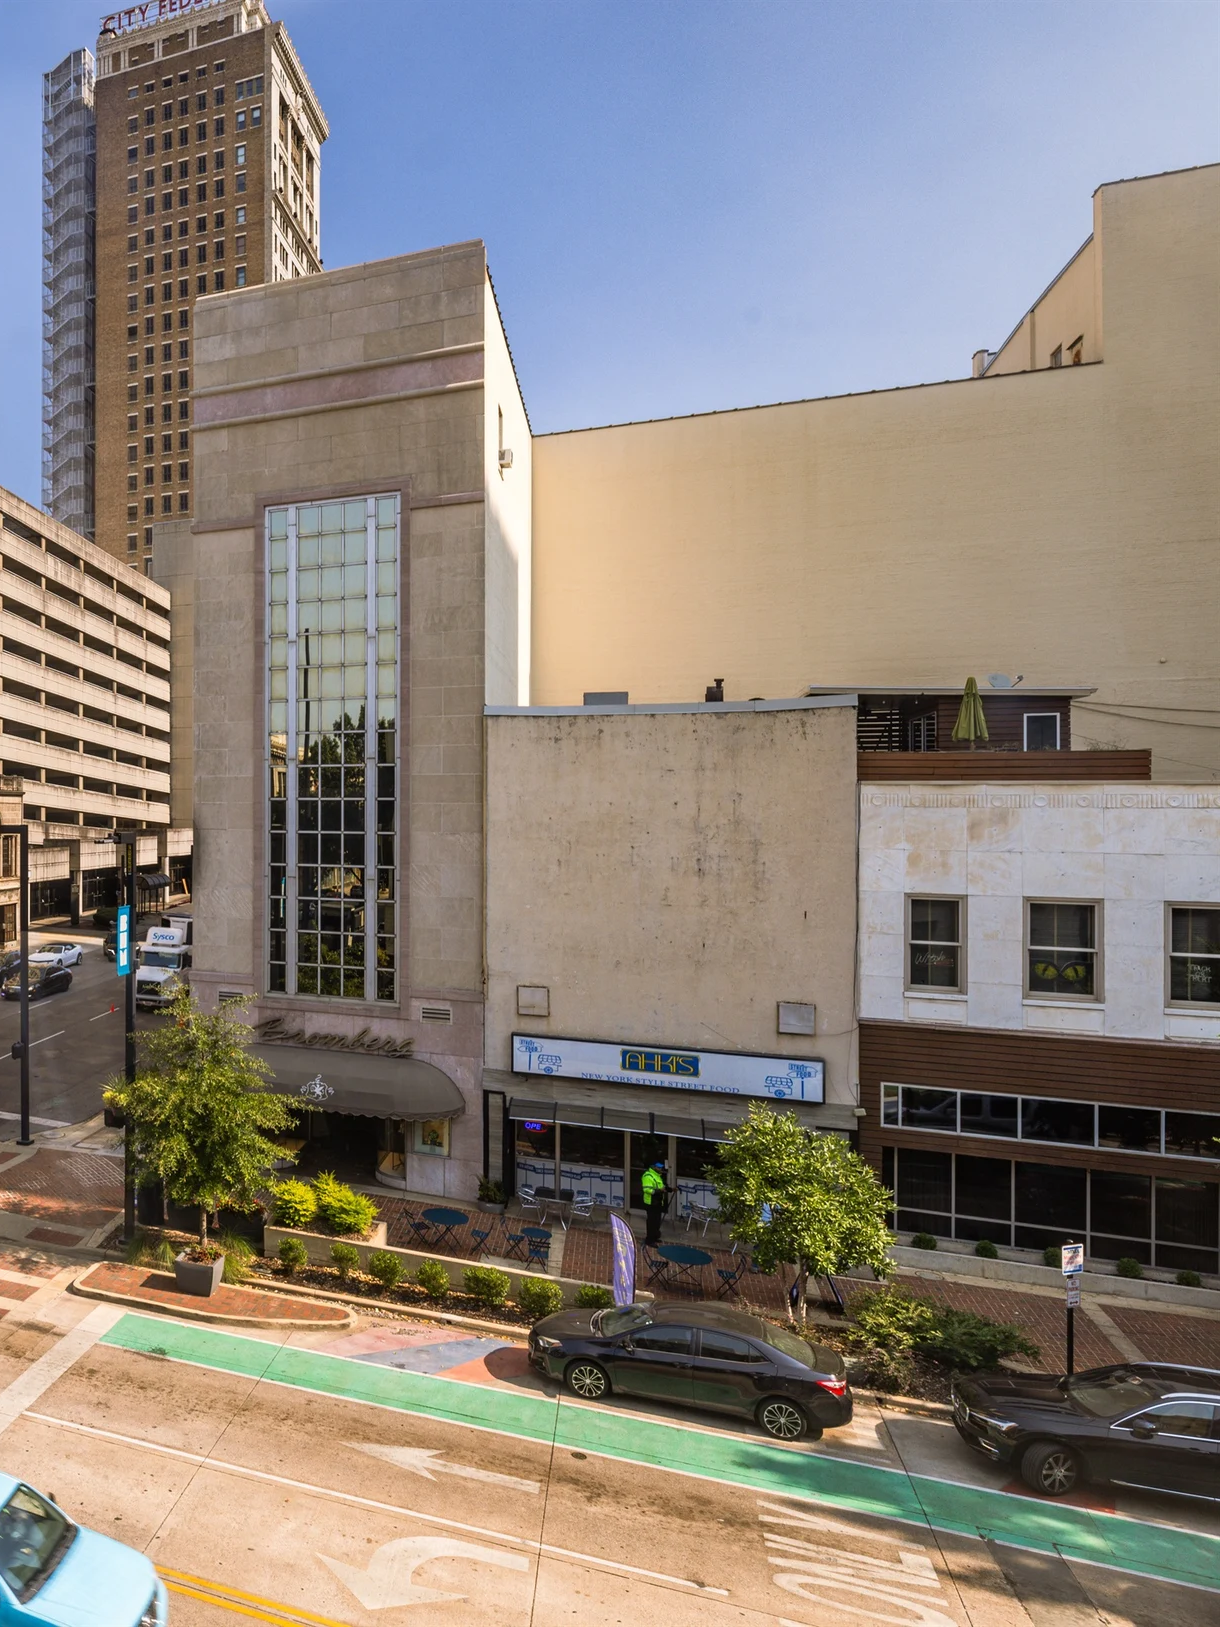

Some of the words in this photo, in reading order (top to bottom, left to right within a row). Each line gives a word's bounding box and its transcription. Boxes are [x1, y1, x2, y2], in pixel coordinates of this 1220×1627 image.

[103, 4, 150, 31] CITY
[153, 932, 175, 942] Sysco
[625, 1051, 694, 1075] AHKI'S
[581, 1072, 604, 1080] NEW
[605, 1074, 633, 1083] YORK
[635, 1077, 666, 1087] STYLE
[668, 1081, 707, 1091] STREET
[709, 1085, 740, 1094] FOOD
